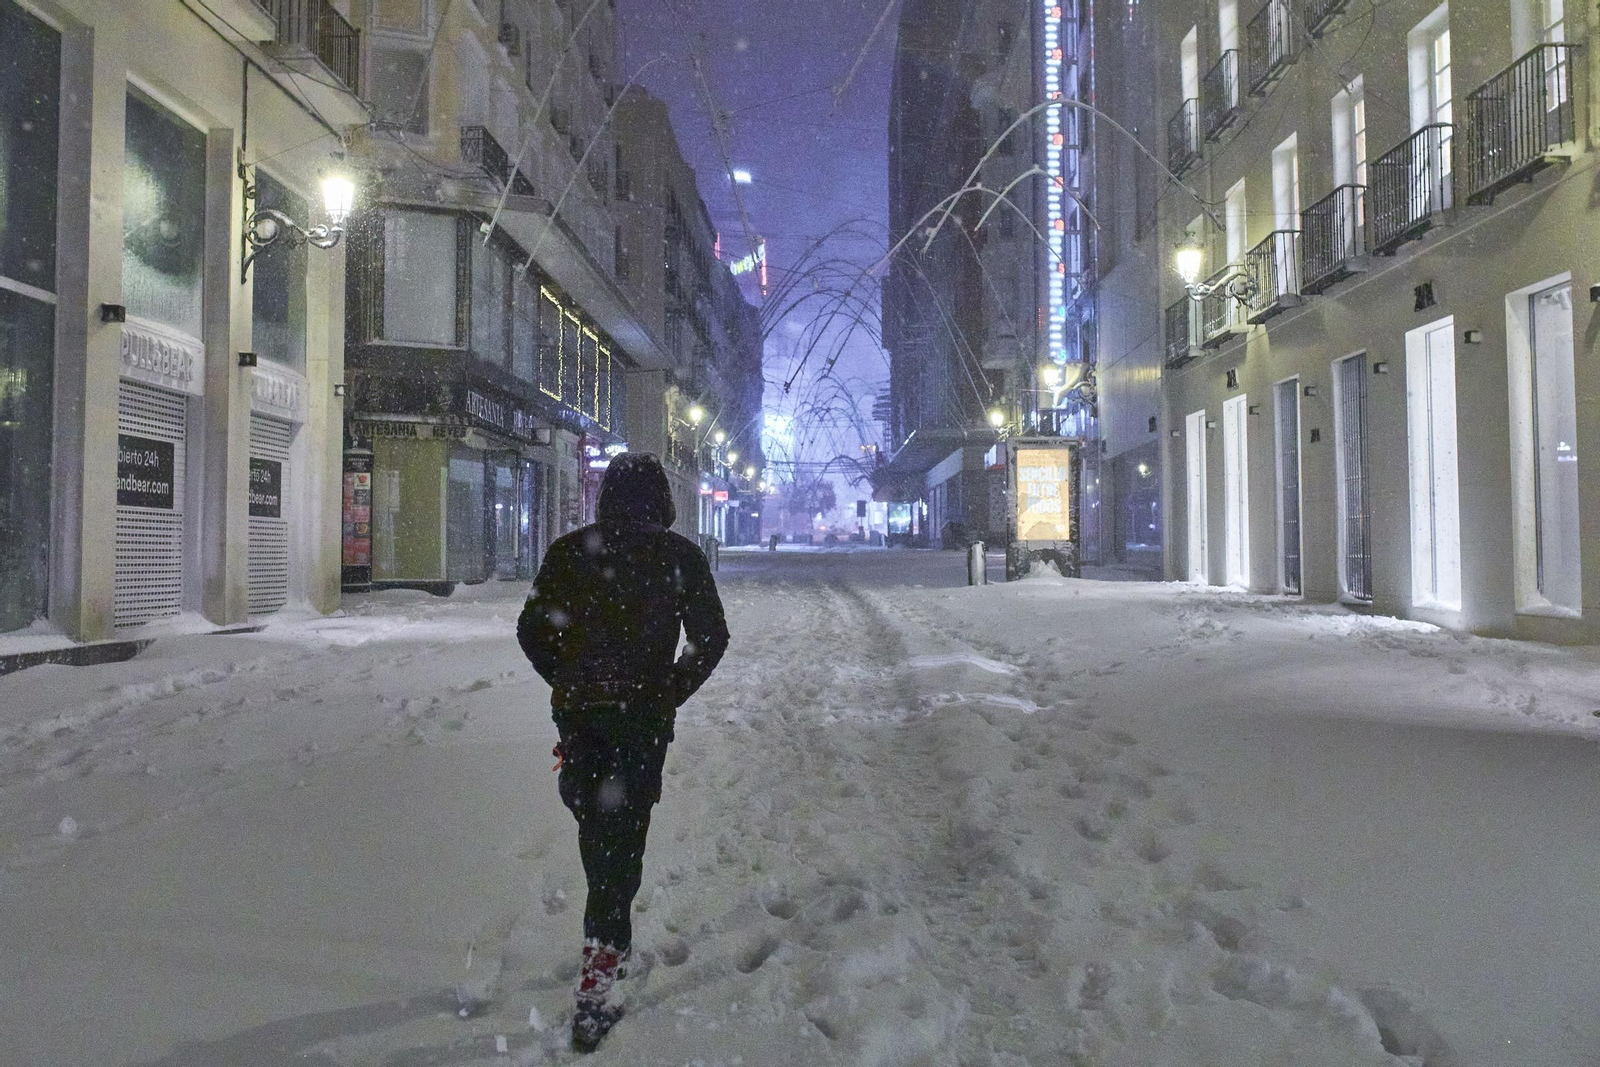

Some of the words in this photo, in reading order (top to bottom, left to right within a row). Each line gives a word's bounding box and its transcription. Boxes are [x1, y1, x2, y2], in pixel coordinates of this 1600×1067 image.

[121, 330, 193, 382] PULL&BEAR
[465, 389, 504, 428] ARTESANIA
[354, 421, 417, 438] ARTESANIA
[432, 425, 467, 438] REYES
[144, 450, 159, 468] 24h
[260, 469, 272, 483] 24h
[1019, 466, 1067, 481] SENCILLO
